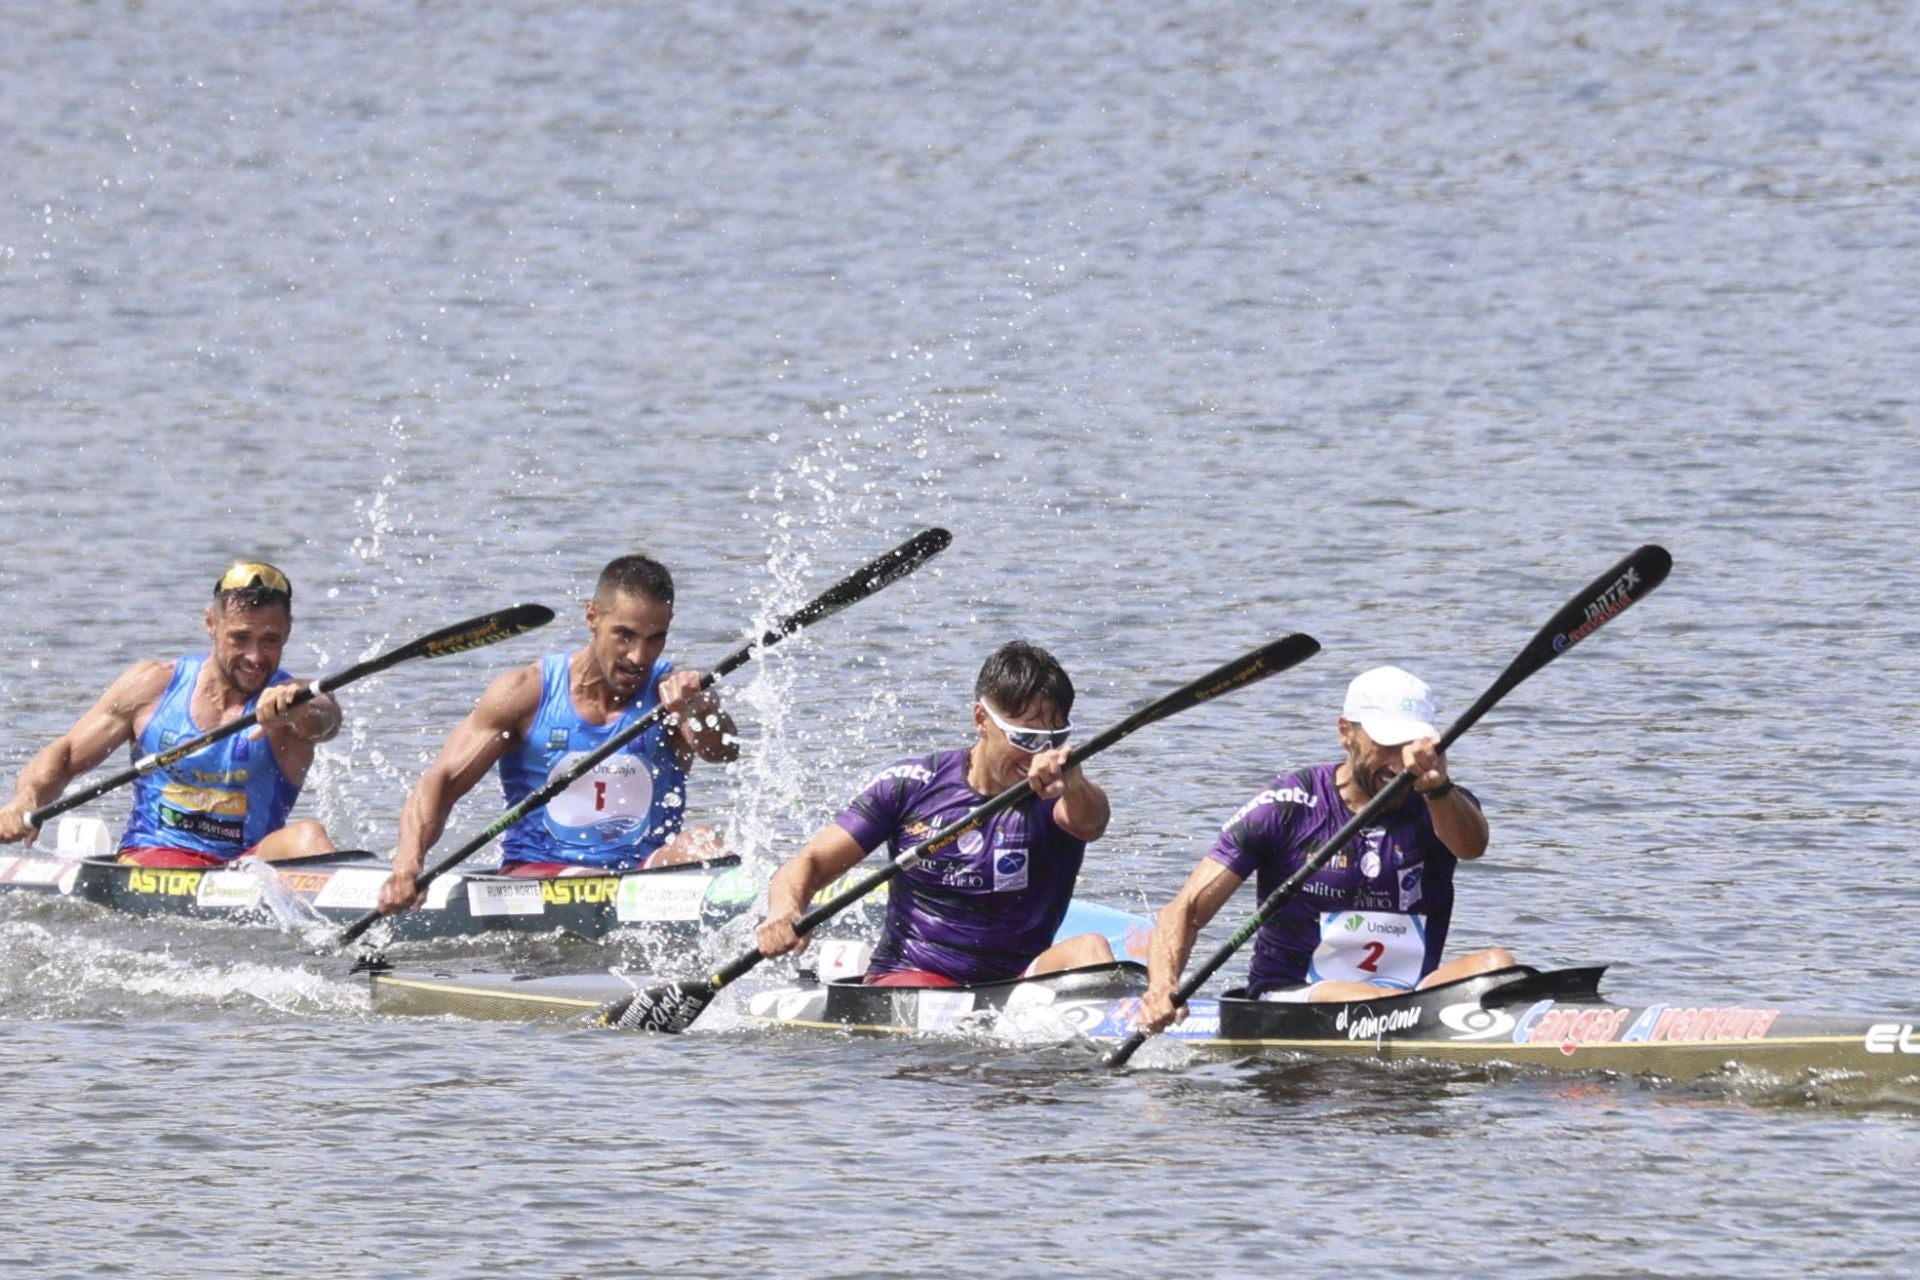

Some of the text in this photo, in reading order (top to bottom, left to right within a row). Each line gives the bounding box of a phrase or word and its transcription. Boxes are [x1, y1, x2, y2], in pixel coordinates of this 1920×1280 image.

[594, 781, 606, 811] 1
[74, 822, 82, 844] 1
[128, 868, 201, 896] ASTOR
[541, 878, 619, 905] ASTOR
[1367, 921, 1407, 938] Unicaja
[833, 945, 844, 967] 2
[1356, 941, 1385, 973] 2
[1336, 1003, 1349, 1031] el
[1512, 1000, 1781, 1055] Cangas Aventura
